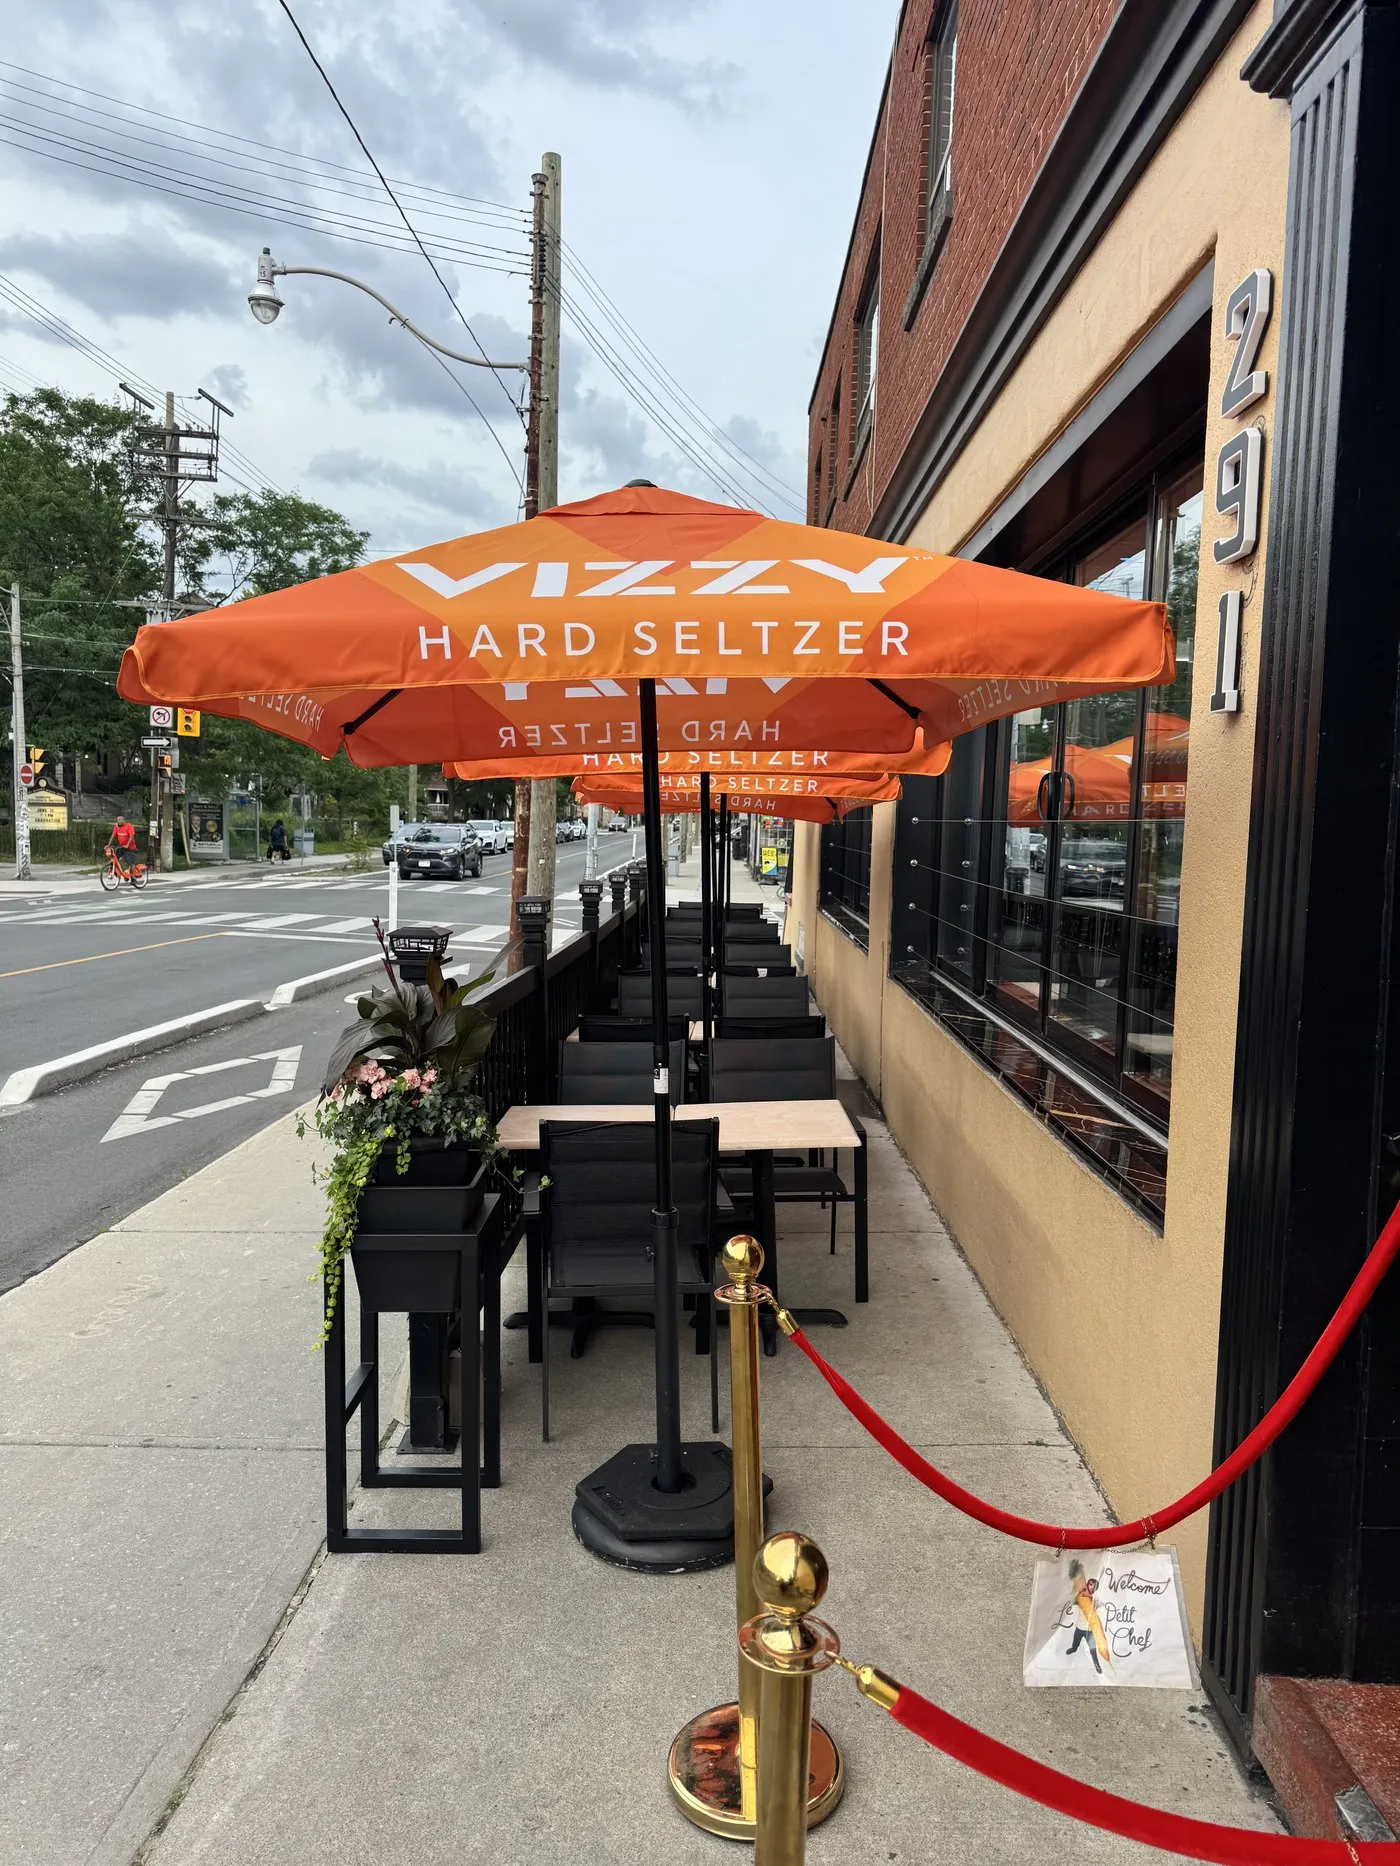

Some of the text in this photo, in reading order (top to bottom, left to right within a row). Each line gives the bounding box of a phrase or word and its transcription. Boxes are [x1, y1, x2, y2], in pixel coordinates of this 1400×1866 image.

[395, 556, 910, 600] VIZZY
[418, 620, 910, 660] HARD SELTZER
[728, 777, 818, 792] SELTZER
[1102, 1567, 1172, 1595] Welcome
[1051, 1600, 1138, 1632] Le Petit
[1108, 1628, 1152, 1657] Chef
